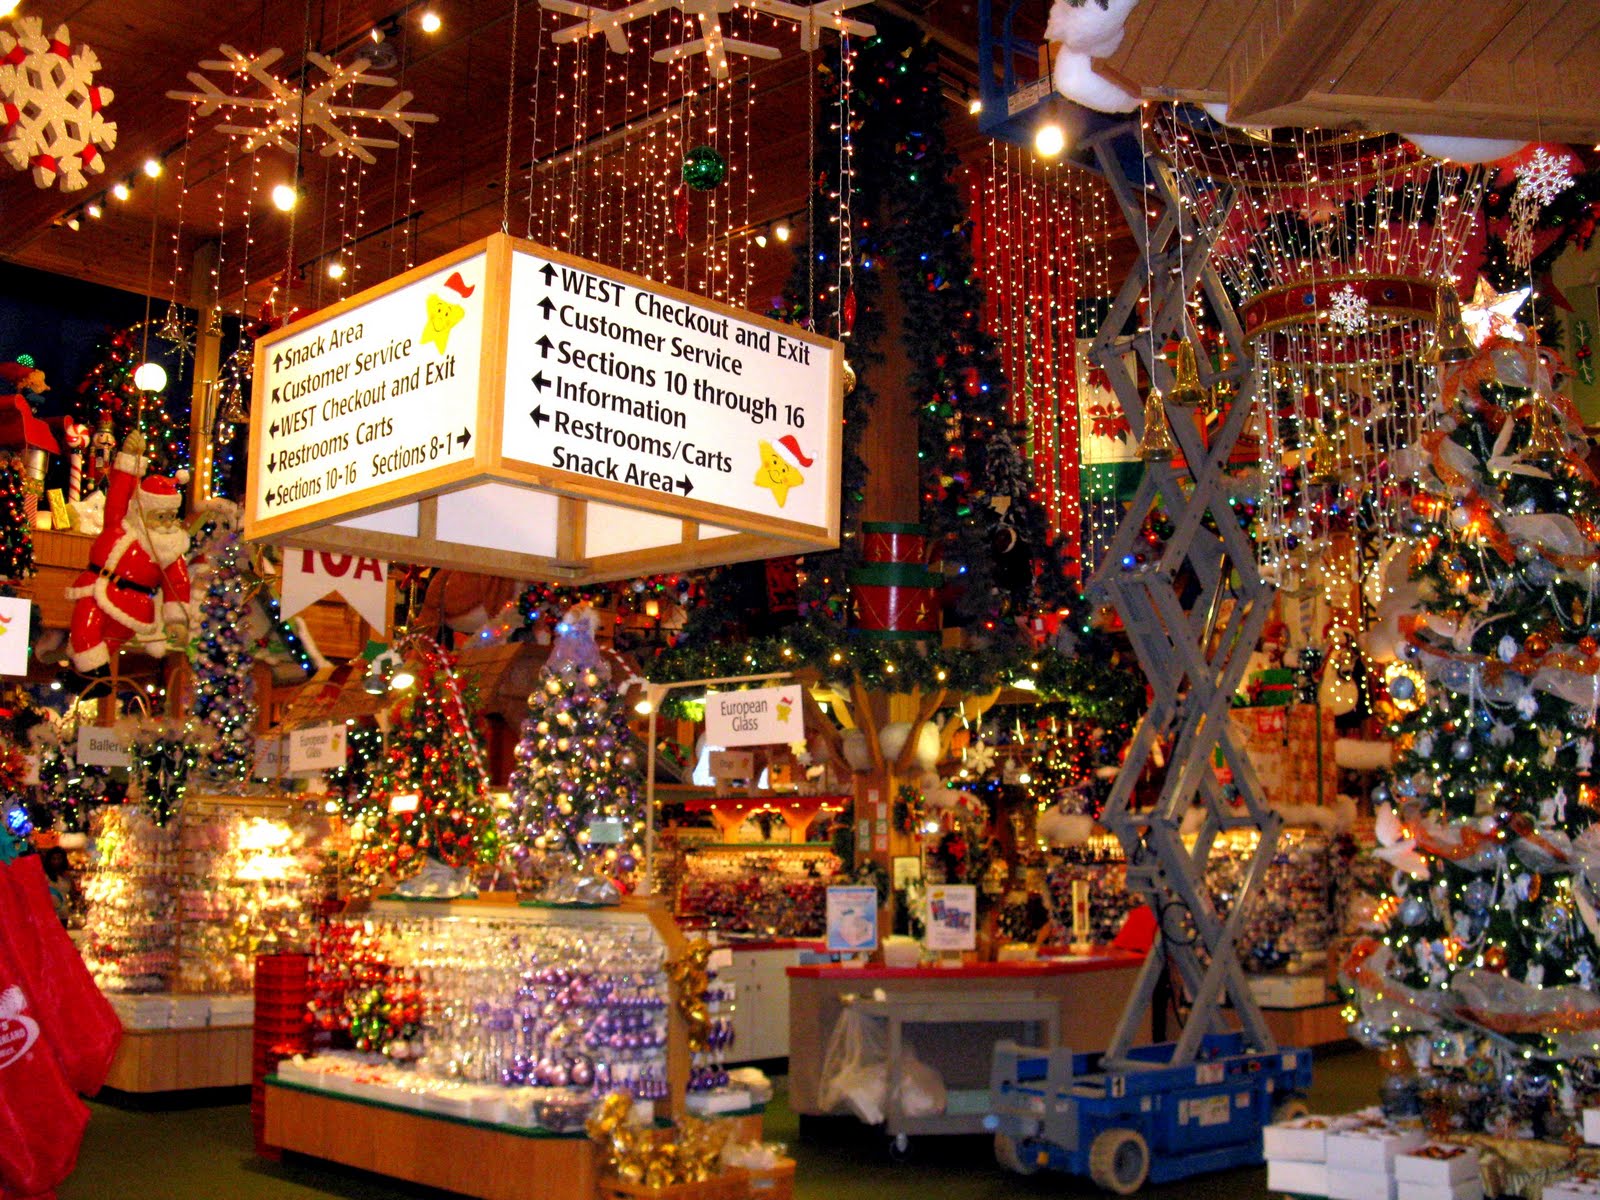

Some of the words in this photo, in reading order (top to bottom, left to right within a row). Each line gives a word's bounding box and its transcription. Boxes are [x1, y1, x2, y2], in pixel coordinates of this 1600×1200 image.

[284, 336, 325, 370] Snack
[329, 323, 363, 351] Area
[560, 305, 666, 351] Customer
[672, 337, 742, 375] Service
[561, 268, 626, 306] WEST
[635, 292, 729, 339] Checkout
[735, 325, 770, 353] and
[777, 336, 810, 366] Exit
[281, 405, 317, 437] WEST
[322, 380, 385, 422] Checkout
[391, 367, 420, 397] and
[426, 354, 455, 386] Exit
[283, 362, 350, 403] Customer
[355, 338, 412, 375] Service
[558, 341, 656, 388] Sections
[665, 370, 688, 396] 10
[693, 379, 777, 424] through
[785, 404, 805, 429] 16
[556, 376, 687, 429] Information
[276, 475, 321, 506] Sections
[326, 461, 357, 490] 10-16
[372, 442, 426, 478] Sections
[430, 432, 452, 460] 8-1
[279, 432, 349, 472] Restrooms
[356, 416, 393, 445] Carts
[552, 446, 618, 481] Snack
[625, 462, 674, 493] Area
[554, 411, 732, 473] Restrooms/Carts
[720, 700, 768, 718] European
[732, 716, 758, 732] Glass
